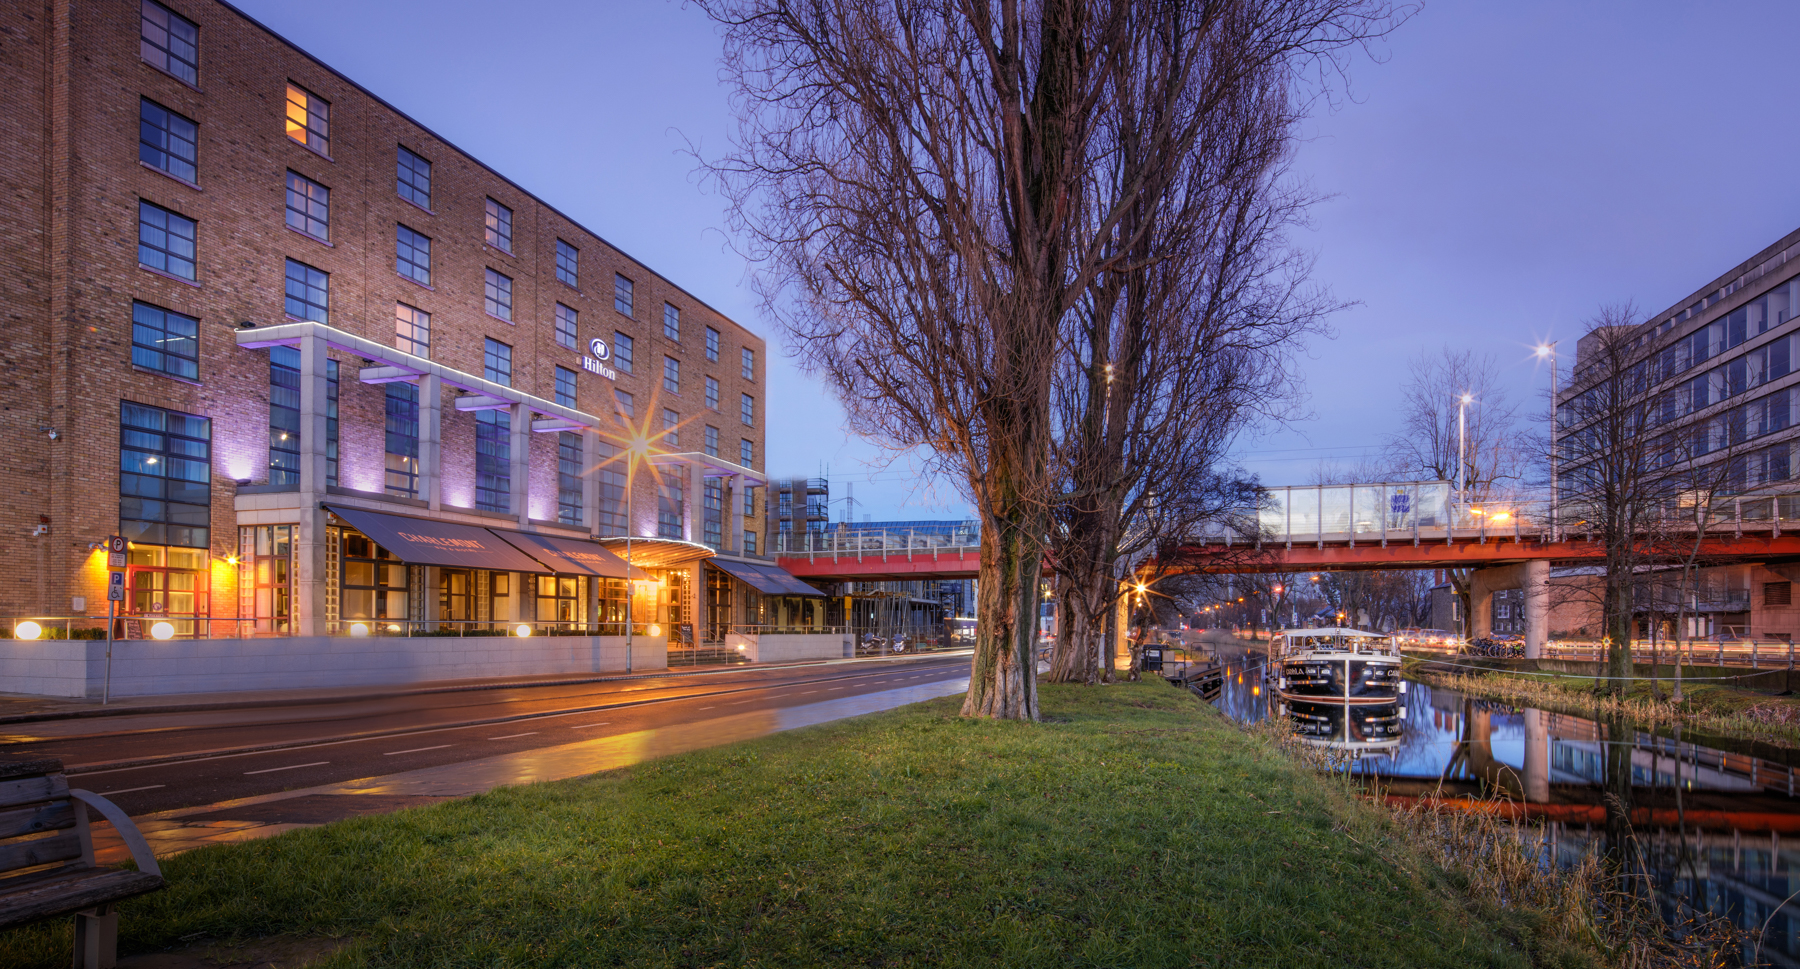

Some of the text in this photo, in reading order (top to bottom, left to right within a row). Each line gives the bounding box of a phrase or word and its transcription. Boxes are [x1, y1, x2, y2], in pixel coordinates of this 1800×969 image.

[582, 356, 615, 380] Hilton
[115, 540, 121, 549] P
[398, 532, 485, 549] CHARLEMONT
[114, 574, 120, 584] P
